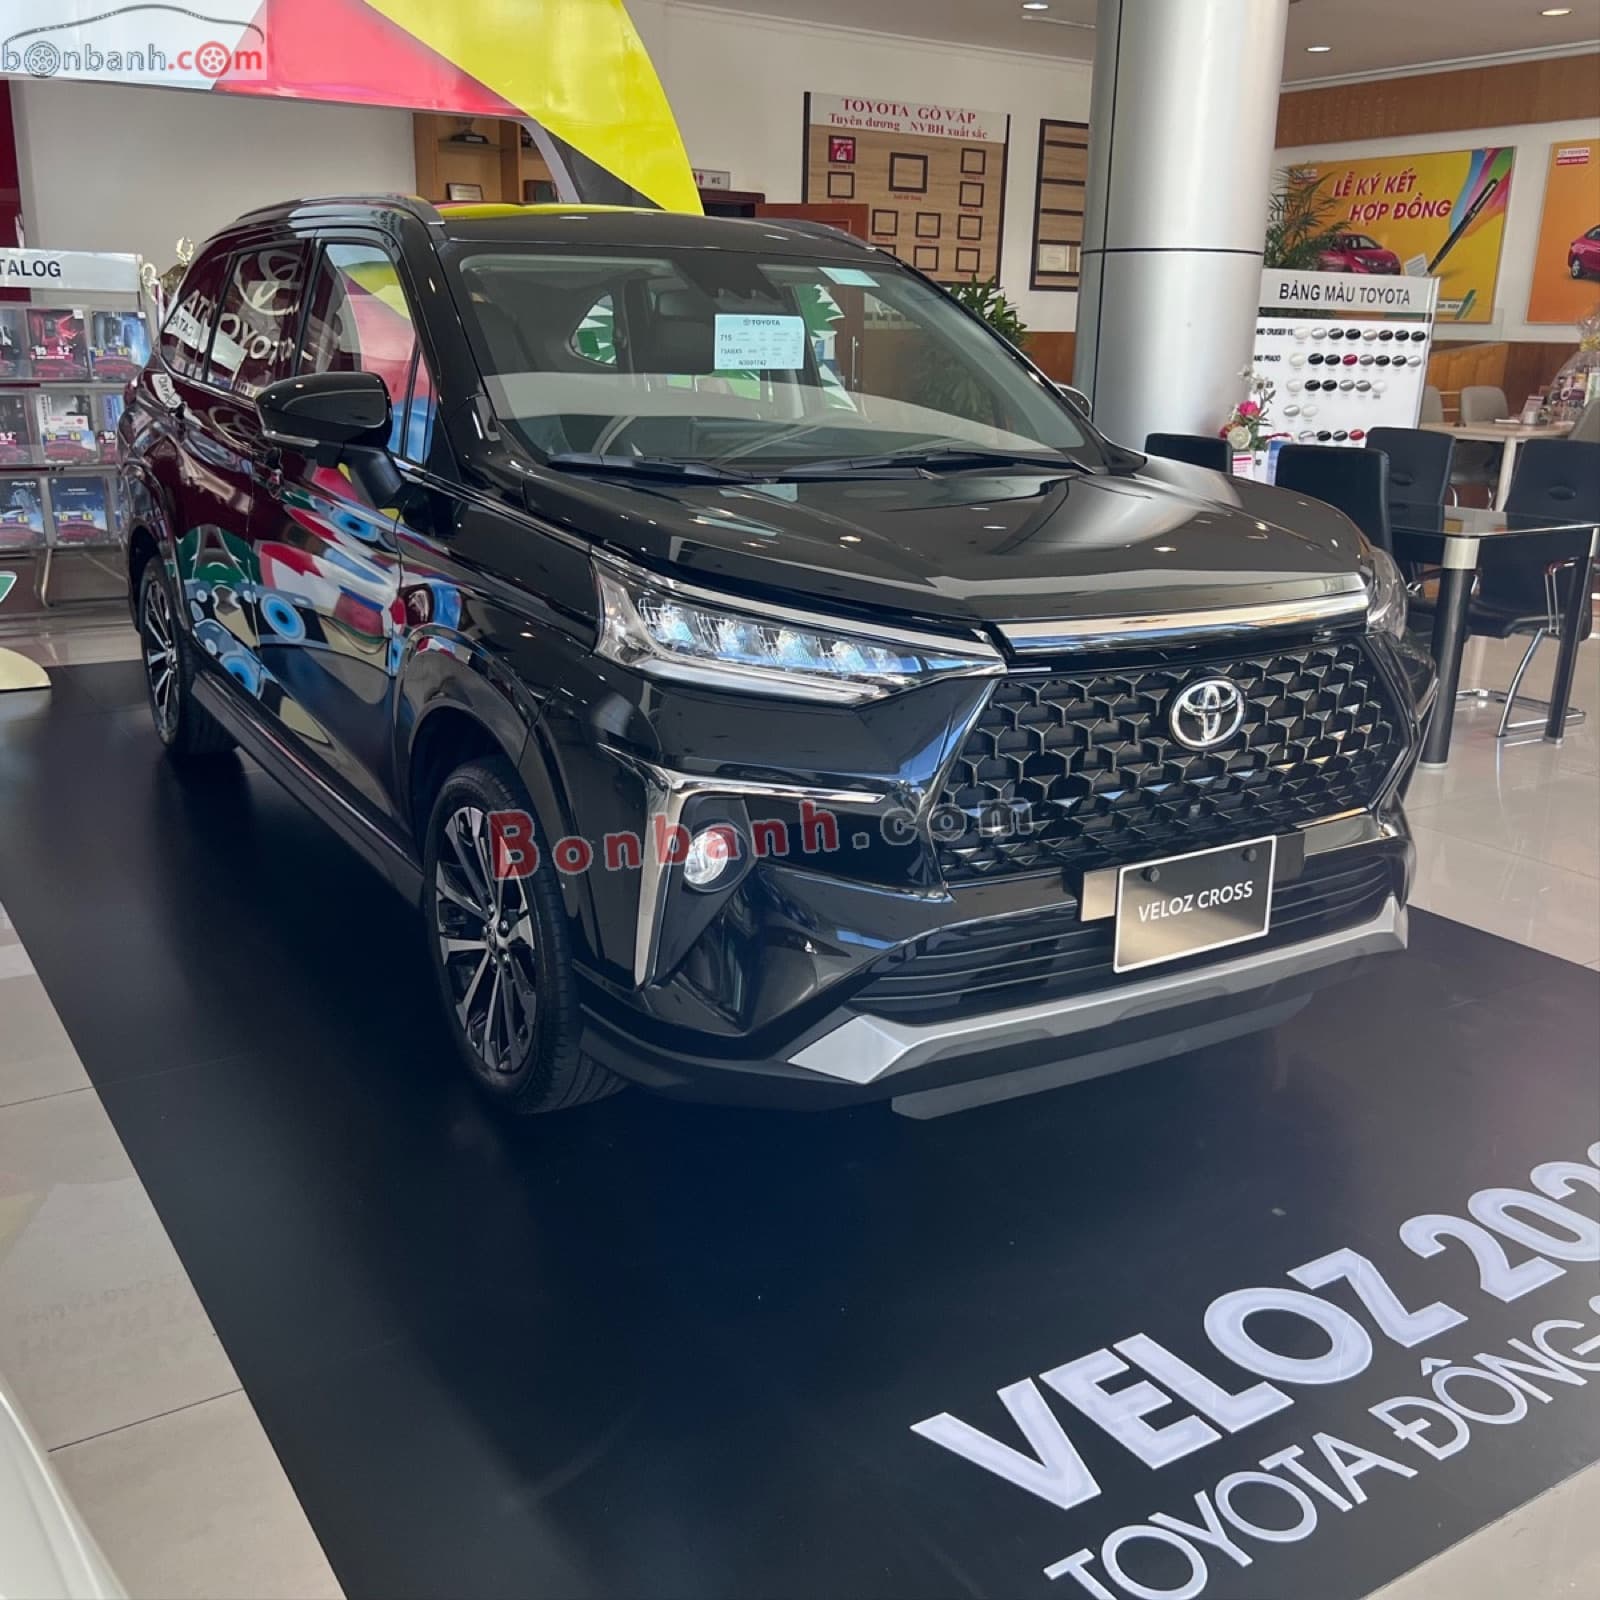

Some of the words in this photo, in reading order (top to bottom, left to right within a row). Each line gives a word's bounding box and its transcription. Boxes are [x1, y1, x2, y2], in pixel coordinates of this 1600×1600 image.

[842, 98, 909, 117] TOYOTA
[917, 107, 942, 121] GÒ
[829, 113, 863, 127] Tuyên
[865, 117, 900, 131] dương
[910, 121, 944, 134] NVBH
[947, 123, 970, 138] xuất
[1334, 171, 1355, 197] LỄ
[1356, 172, 1381, 196] KÝ
[1384, 168, 1416, 193] KẾT
[1350, 202, 1389, 226] HỢP
[1393, 192, 1452, 219] ĐỒNG
[1279, 280, 1320, 301] BẢNG
[1324, 282, 1355, 303] MÀU
[1360, 287, 1410, 305] TOYOTA
[1138, 894, 1194, 922] VELOZ
[1196, 881, 1253, 909] CROSS
[910, 1248, 1468, 1510] VELOZ
[1043, 1432, 1418, 1600] TOYOTA
[1368, 1319, 1600, 1460] ĐÔNG
